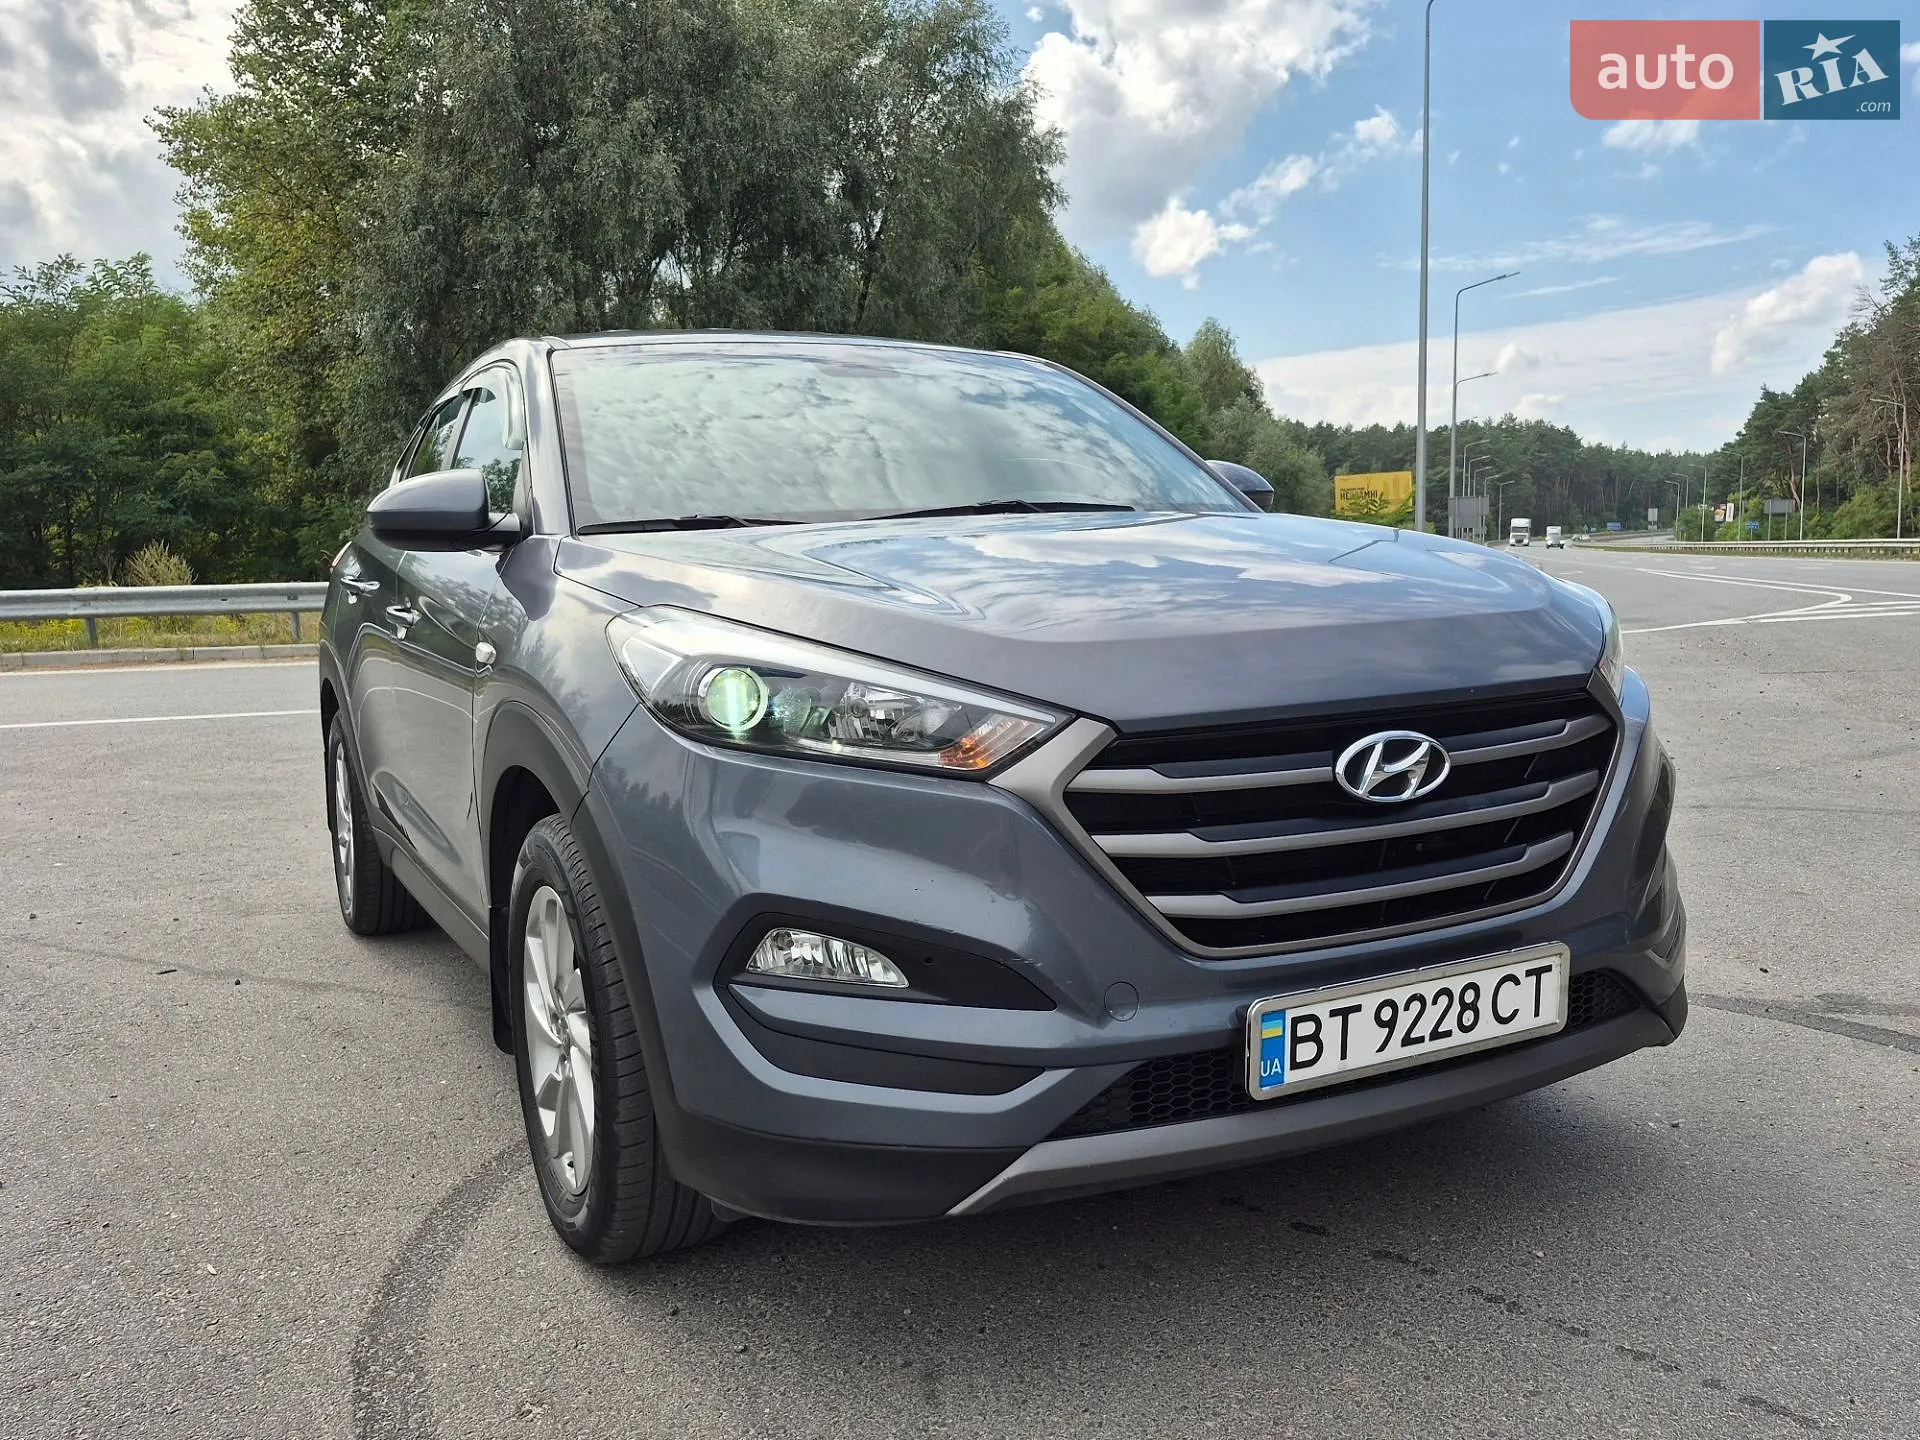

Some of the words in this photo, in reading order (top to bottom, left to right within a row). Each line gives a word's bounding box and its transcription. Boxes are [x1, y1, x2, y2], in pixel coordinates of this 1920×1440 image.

[1289, 1003, 1362, 1071] BT
[1373, 982, 1481, 1053] 9228
[1491, 964, 1553, 1025] CT
[1260, 1057, 1282, 1077] UA
